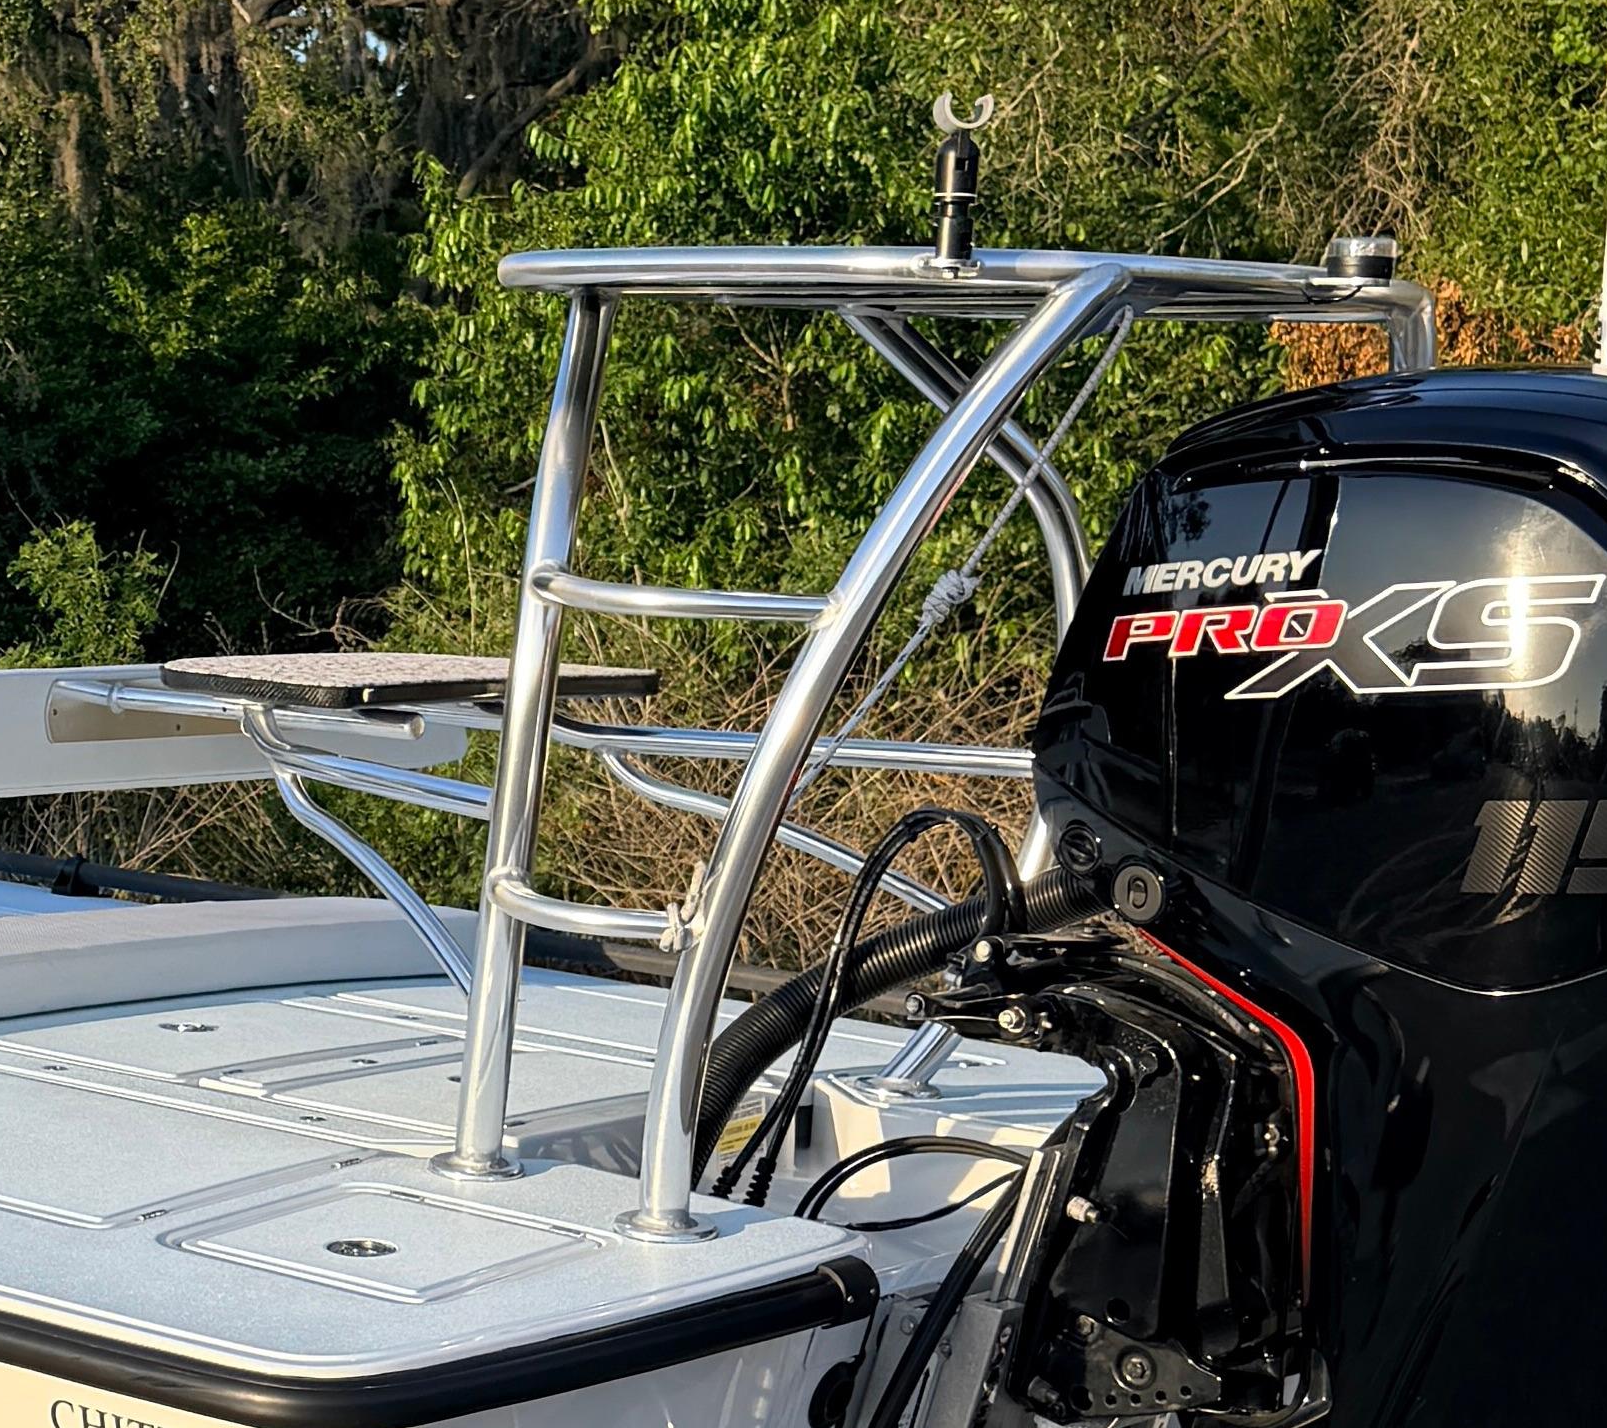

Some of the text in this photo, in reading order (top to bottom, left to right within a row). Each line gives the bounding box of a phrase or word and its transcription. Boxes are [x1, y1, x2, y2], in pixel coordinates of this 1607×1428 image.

[1123, 548, 1322, 597] MERCURY
[1102, 573, 1607, 700] PRO XS
